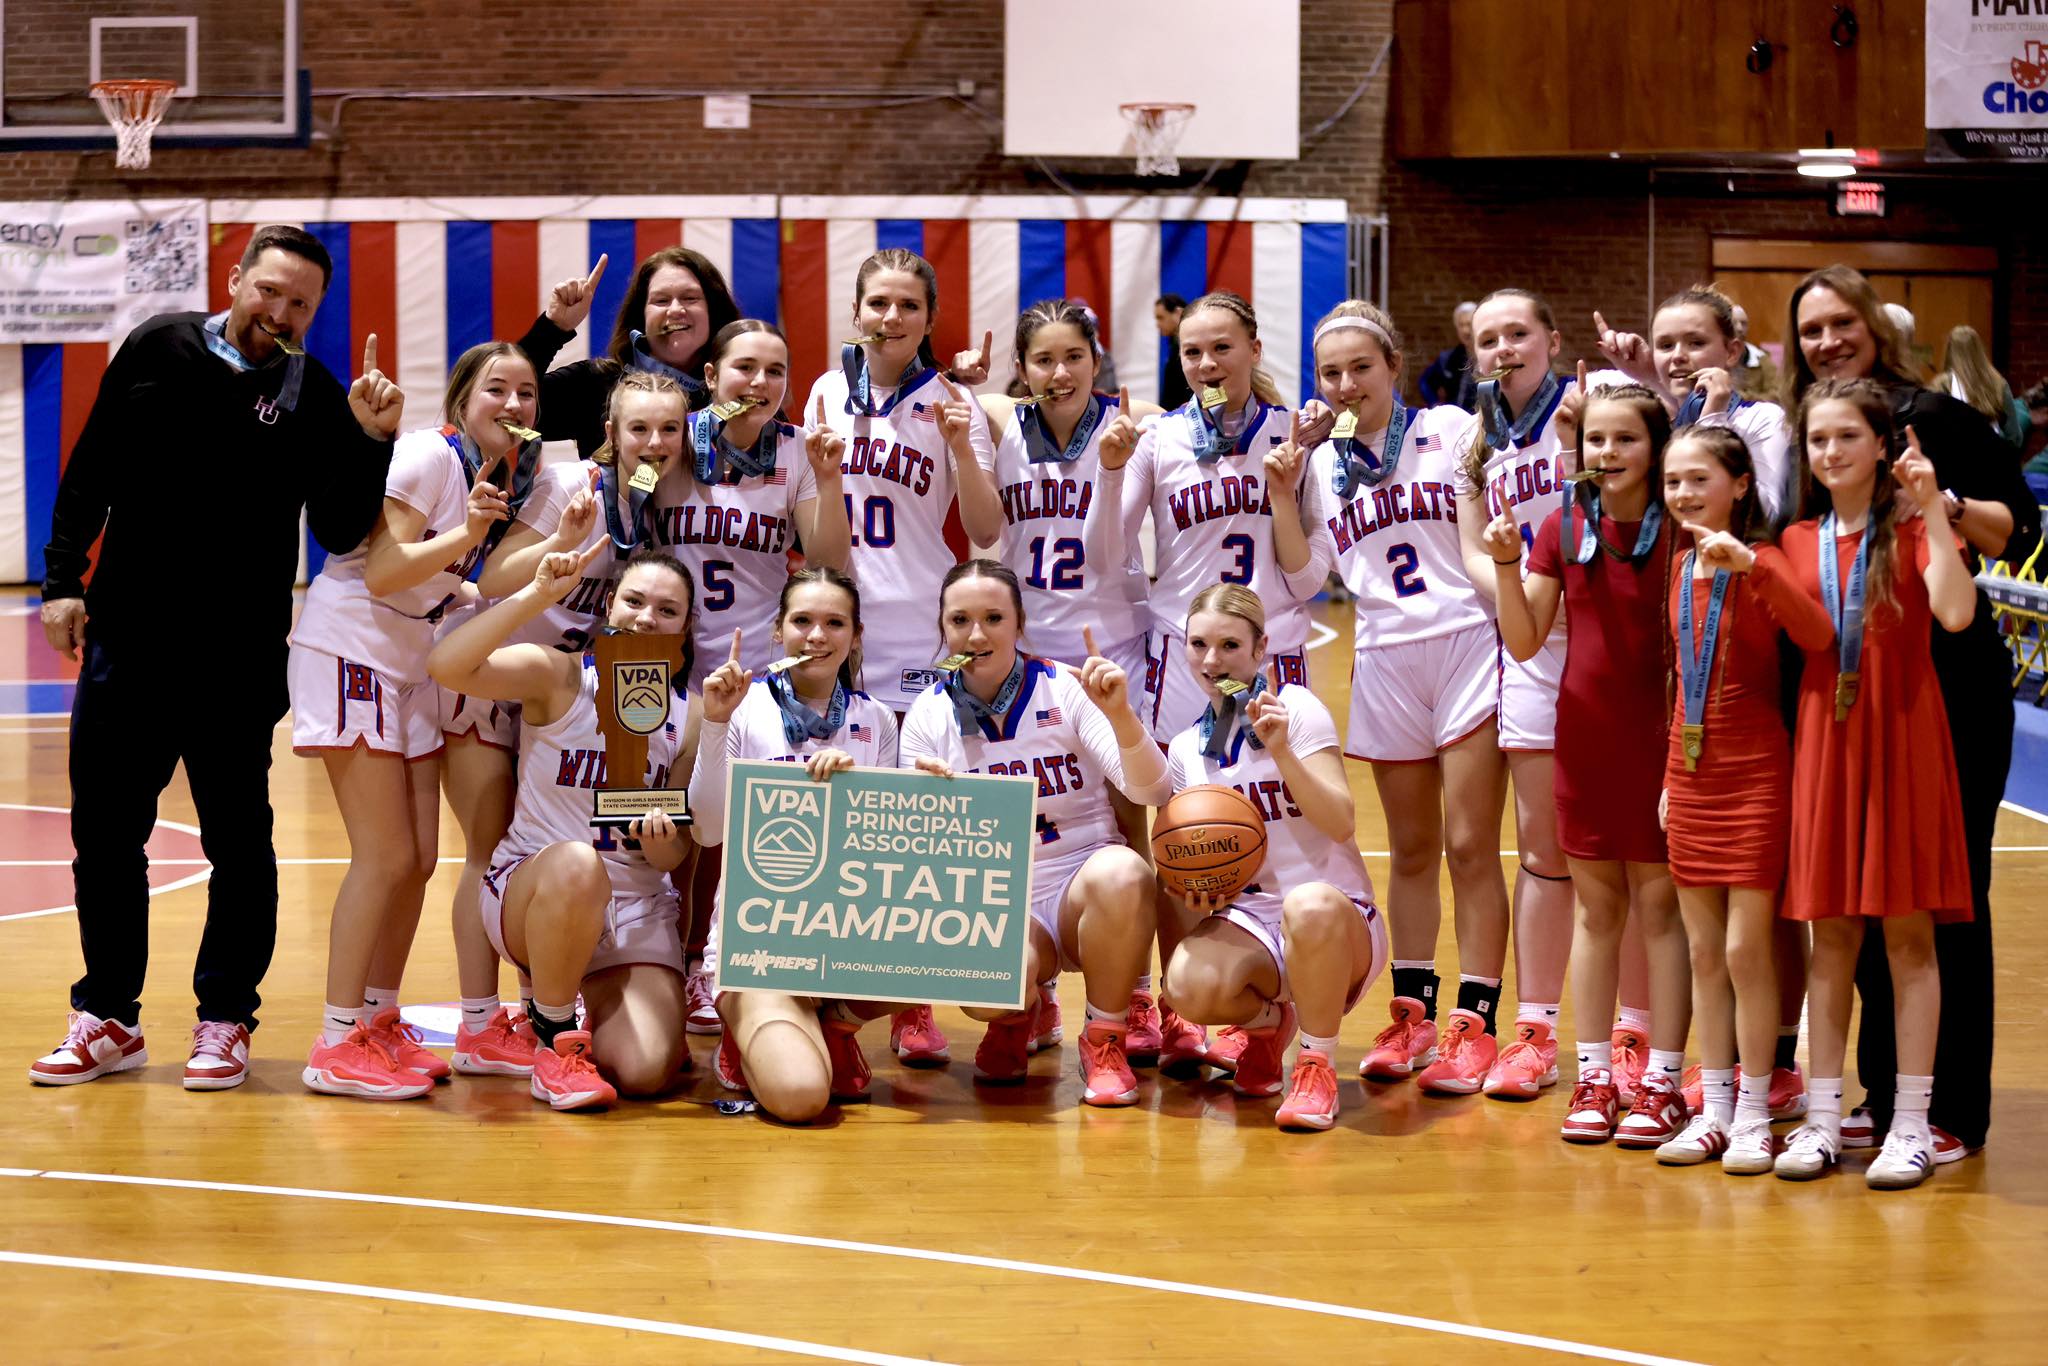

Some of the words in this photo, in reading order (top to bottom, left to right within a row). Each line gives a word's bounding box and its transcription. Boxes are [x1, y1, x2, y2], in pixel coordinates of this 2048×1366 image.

[1986, 22, 2015, 32] PRICE
[1965, 131, 1995, 143] We're
[1998, 132, 2016, 143] not
[2019, 131, 2041, 145] just
[2009, 144, 2040, 156] we're
[697, 420, 708, 446] 2025
[1066, 438, 1083, 458] 2025
[1081, 409, 1096, 432] 2026
[1387, 433, 1401, 456] 2025
[654, 505, 788, 554] WILDCATS
[1328, 481, 1459, 556] WILDCATS
[1025, 536, 1085, 590] 12
[1220, 533, 1255, 586] 3
[1386, 542, 1428, 598] 2
[702, 560, 736, 612] 5
[1694, 639, 1712, 699] Basketball
[1706, 610, 1718, 637] 2025
[1712, 573, 1727, 600] 2026
[621, 669, 664, 686] VPA
[1004, 671, 1021, 696] 2026
[755, 787, 821, 818] VPA
[846, 788, 973, 814] VERMONT
[845, 811, 999, 837] PRINCIPALS'
[842, 832, 1012, 860] ASSOCIATION
[1164, 834, 1241, 861] SPALDING
[837, 860, 1012, 906] STATE
[1173, 867, 1241, 888] LEGACY
[736, 897, 1009, 948] CHAMPION
[729, 949, 818, 977] MAXPREPS
[831, 961, 1012, 981] VPAONLINE.ORG/VTSCOREBOARD
